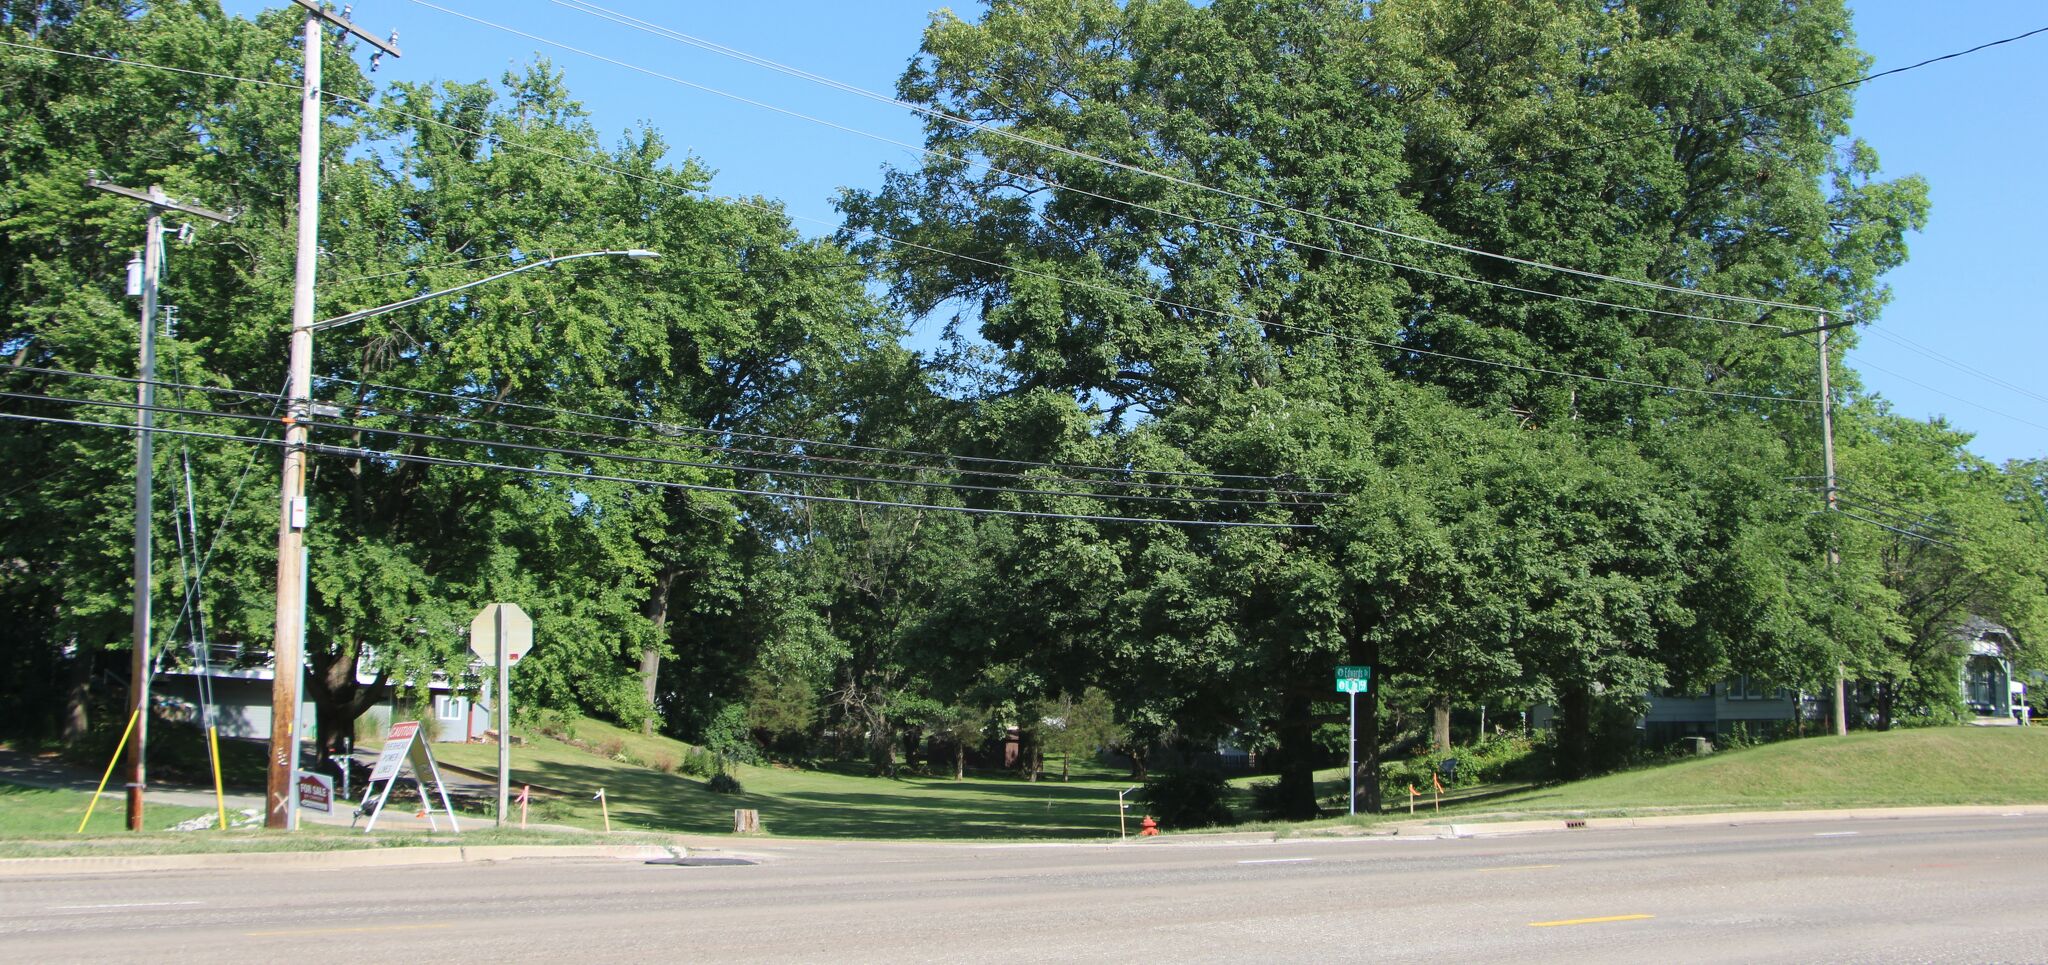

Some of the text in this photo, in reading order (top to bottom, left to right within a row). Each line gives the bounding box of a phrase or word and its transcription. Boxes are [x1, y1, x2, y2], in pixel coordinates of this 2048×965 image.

[1344, 667, 1363, 678] Edwards
[390, 725, 417, 738] CAUTION
[301, 783, 327, 797] FOR SALE
